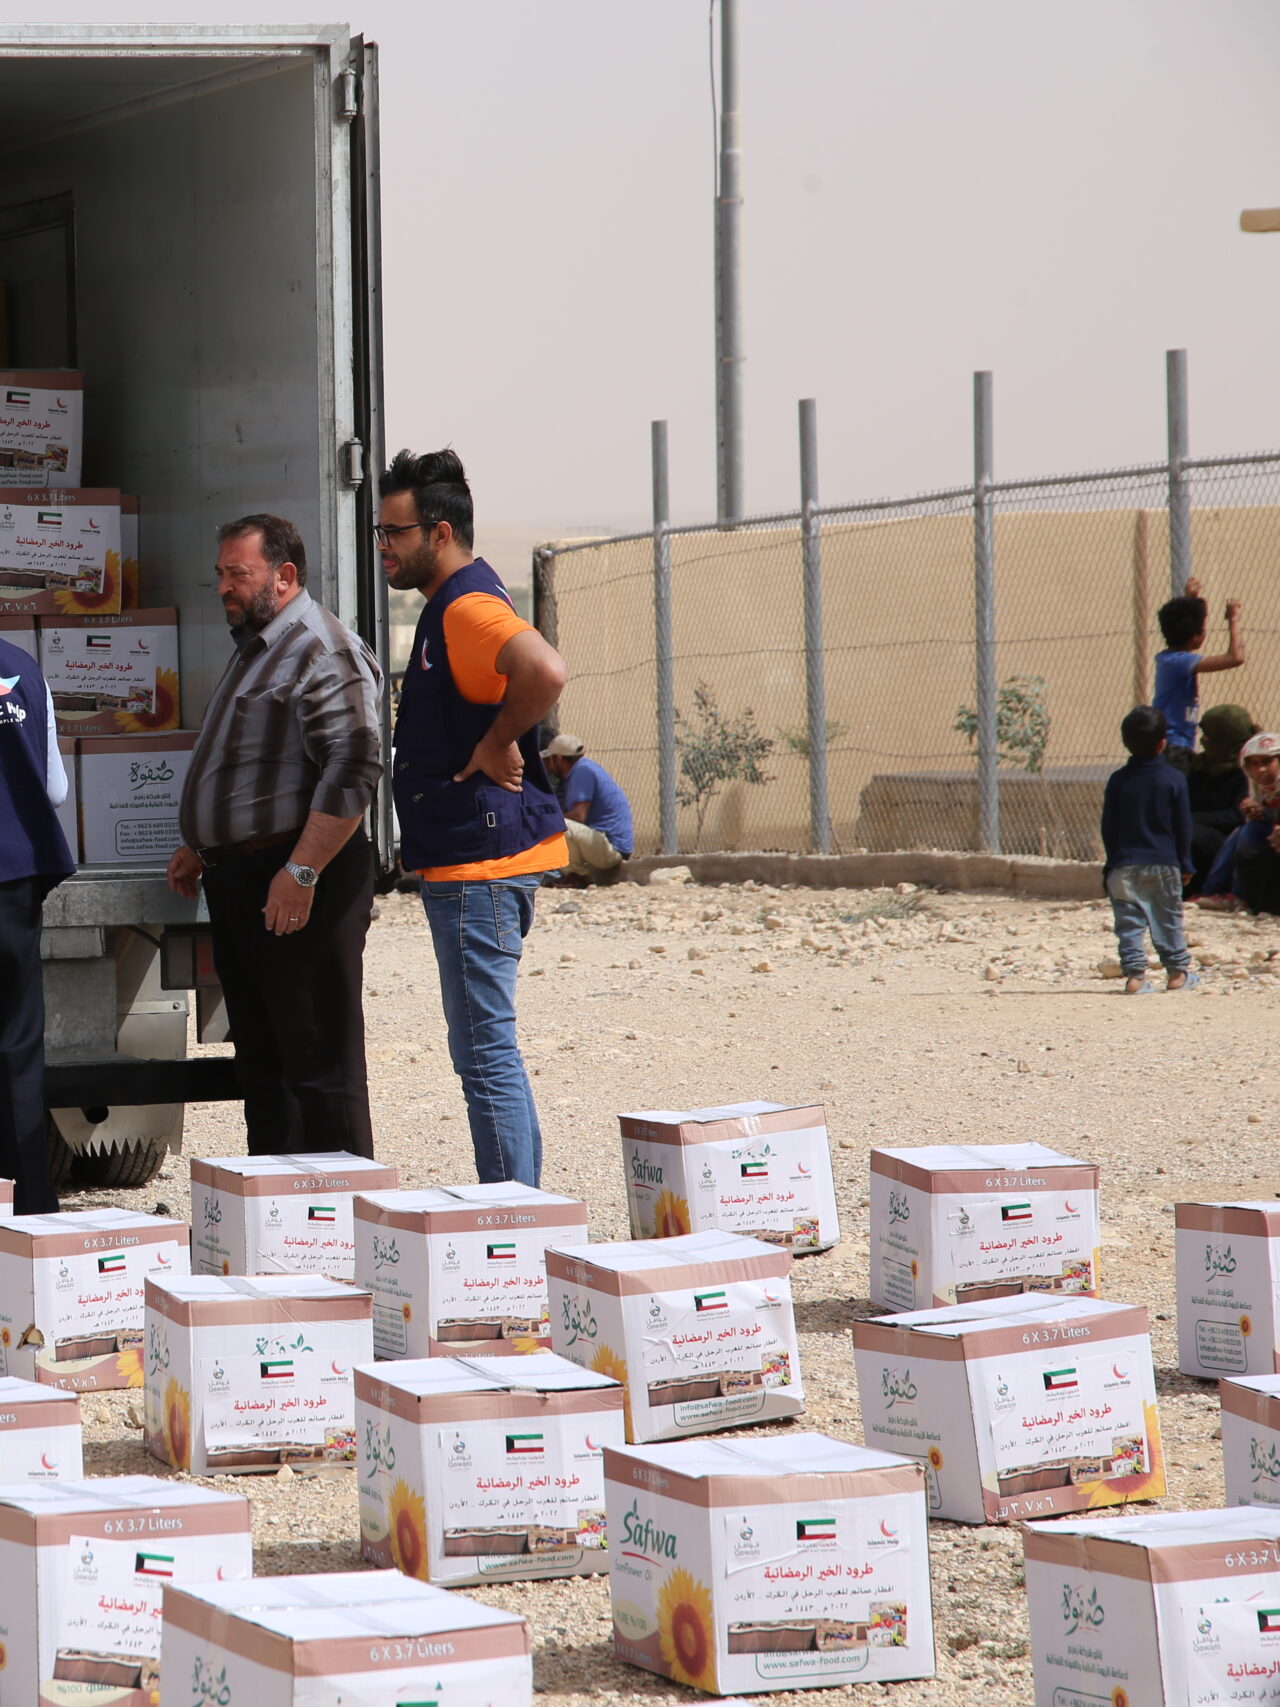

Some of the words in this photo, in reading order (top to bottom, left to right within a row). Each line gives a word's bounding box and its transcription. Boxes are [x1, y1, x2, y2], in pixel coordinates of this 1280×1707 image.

[7, 702, 26, 721] Hlp
[631, 1148, 663, 1184] Safwa
[294, 1181, 299, 1189] 6
[310, 1179, 323, 1188] 3.7
[326, 1179, 349, 1187] Liters
[986, 1178, 992, 1187] 6
[994, 1177, 1001, 1186] X
[1004, 1177, 1017, 1187] 3.7
[1020, 1177, 1046, 1186] Liters
[478, 1216, 483, 1225] 6
[486, 1216, 492, 1224] X
[495, 1215, 508, 1224] 3.7
[511, 1214, 535, 1223] Liters
[85, 1239, 90, 1248] 6
[92, 1239, 98, 1247] X
[100, 1237, 113, 1247] 3.7
[116, 1236, 140, 1245] Liters
[1023, 1333, 1030, 1344] 6
[1033, 1333, 1040, 1342] X
[1043, 1330, 1058, 1342] 3.7
[1062, 1326, 1090, 1338] Liters
[234, 1398, 275, 1413] الرمضانية
[279, 1398, 299, 1410] الخير
[303, 1396, 327, 1408] طرود
[1067, 1408, 1086, 1424] الخير
[1089, 1404, 1112, 1419] طرود
[1022, 1412, 1063, 1429] الرمضانية
[476, 1477, 522, 1492] الرمضانية
[527, 1477, 550, 1491] الخير
[554, 1475, 580, 1488] طرود
[105, 1520, 112, 1533] 6
[116, 1518, 124, 1531] X
[128, 1518, 144, 1530] 3.7
[149, 1516, 183, 1530] Liters
[620, 1499, 677, 1559] Safwa
[485, 1554, 574, 1570] www.safwa-food.com
[846, 1562, 873, 1577] طرود
[764, 1566, 812, 1583] الرمضانية
[819, 1564, 841, 1580] الخير
[371, 1648, 379, 1661] 6
[382, 1647, 391, 1660] X
[395, 1644, 413, 1658] 3.7
[418, 1641, 454, 1657] Liters
[763, 1655, 860, 1669] www.safwa-food.com
